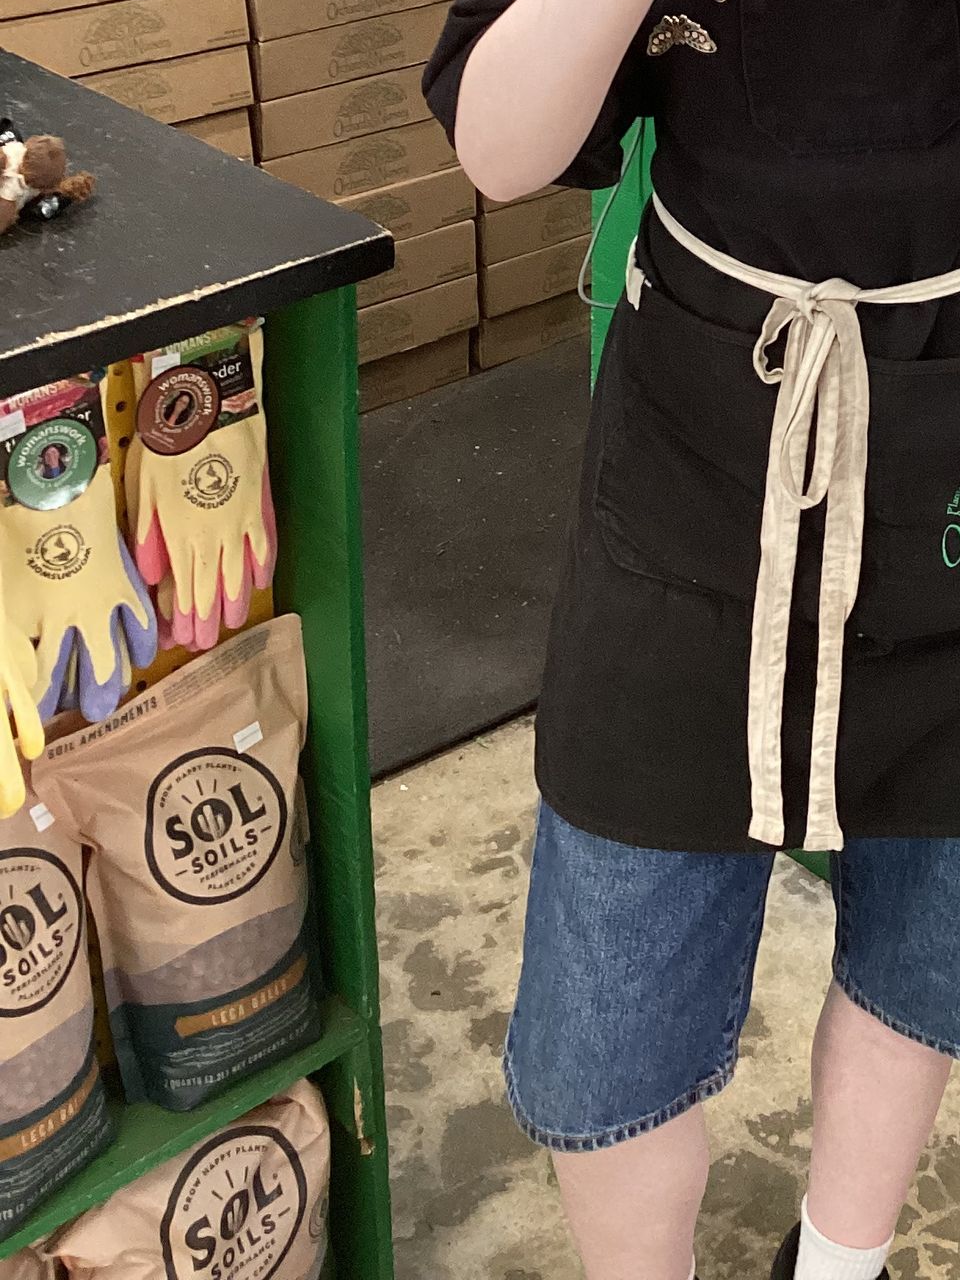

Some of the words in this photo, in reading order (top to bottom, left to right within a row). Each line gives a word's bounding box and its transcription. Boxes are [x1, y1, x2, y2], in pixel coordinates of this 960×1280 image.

[158, 372, 213, 417] womanswork
[16, 423, 88, 468] womanswork
[48, 743, 76, 760] SOIL
[79, 695, 158, 746] AMENDMENTS
[165, 782, 267, 861] SOL
[191, 828, 258, 875] SOILS
[199, 849, 258, 883] PERFORMANCE
[208, 878, 236, 891] PLANT
[236, 862, 256, 881] CARE
[3, 928, 64, 988] SOILS
[11, 950, 64, 996] PERFORMANCE
[18, 985, 44, 1002] PLANT
[183, 1177, 201, 1212] GROW
[202, 1149, 232, 1177] HAPPY
[185, 1161, 284, 1272] SOL
[211, 1213, 276, 1280] SOILS
